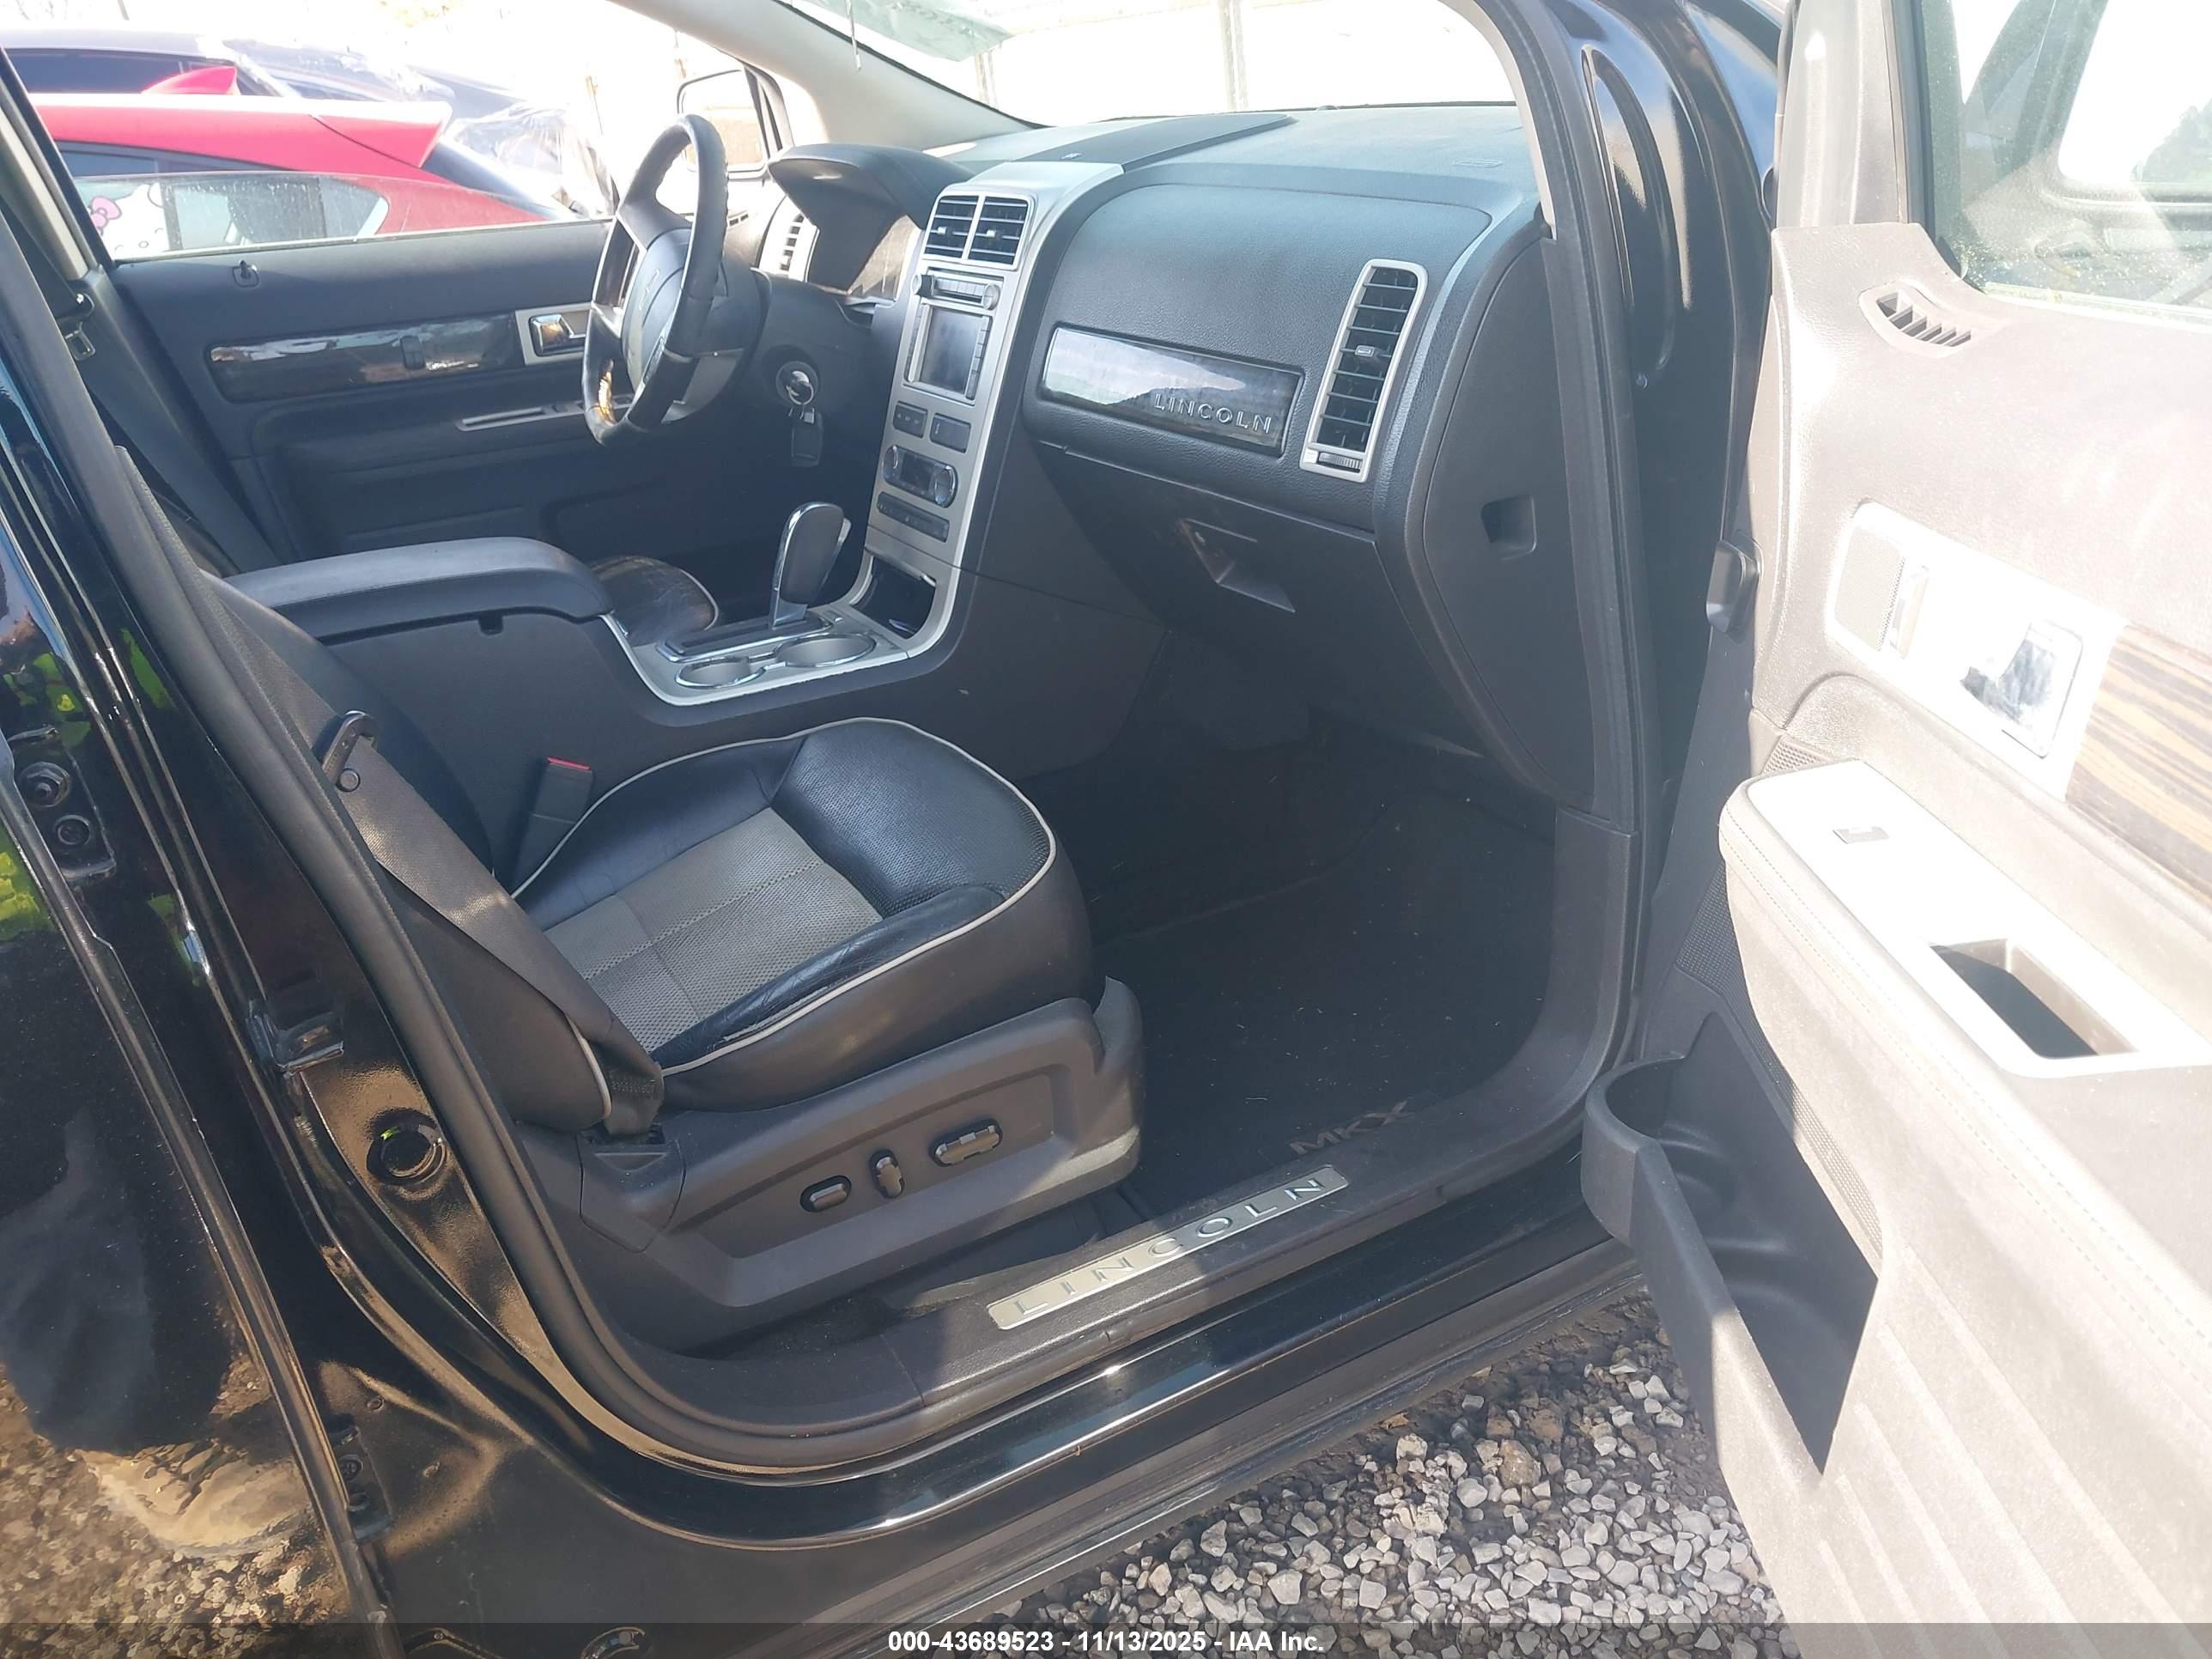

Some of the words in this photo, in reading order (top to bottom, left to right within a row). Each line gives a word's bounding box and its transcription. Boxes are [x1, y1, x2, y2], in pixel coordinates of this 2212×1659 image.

[1153, 392, 1273, 434] LINCOLN
[1289, 1100, 1408, 1155] MKX
[1013, 1177, 1326, 1317] LINCOLN
